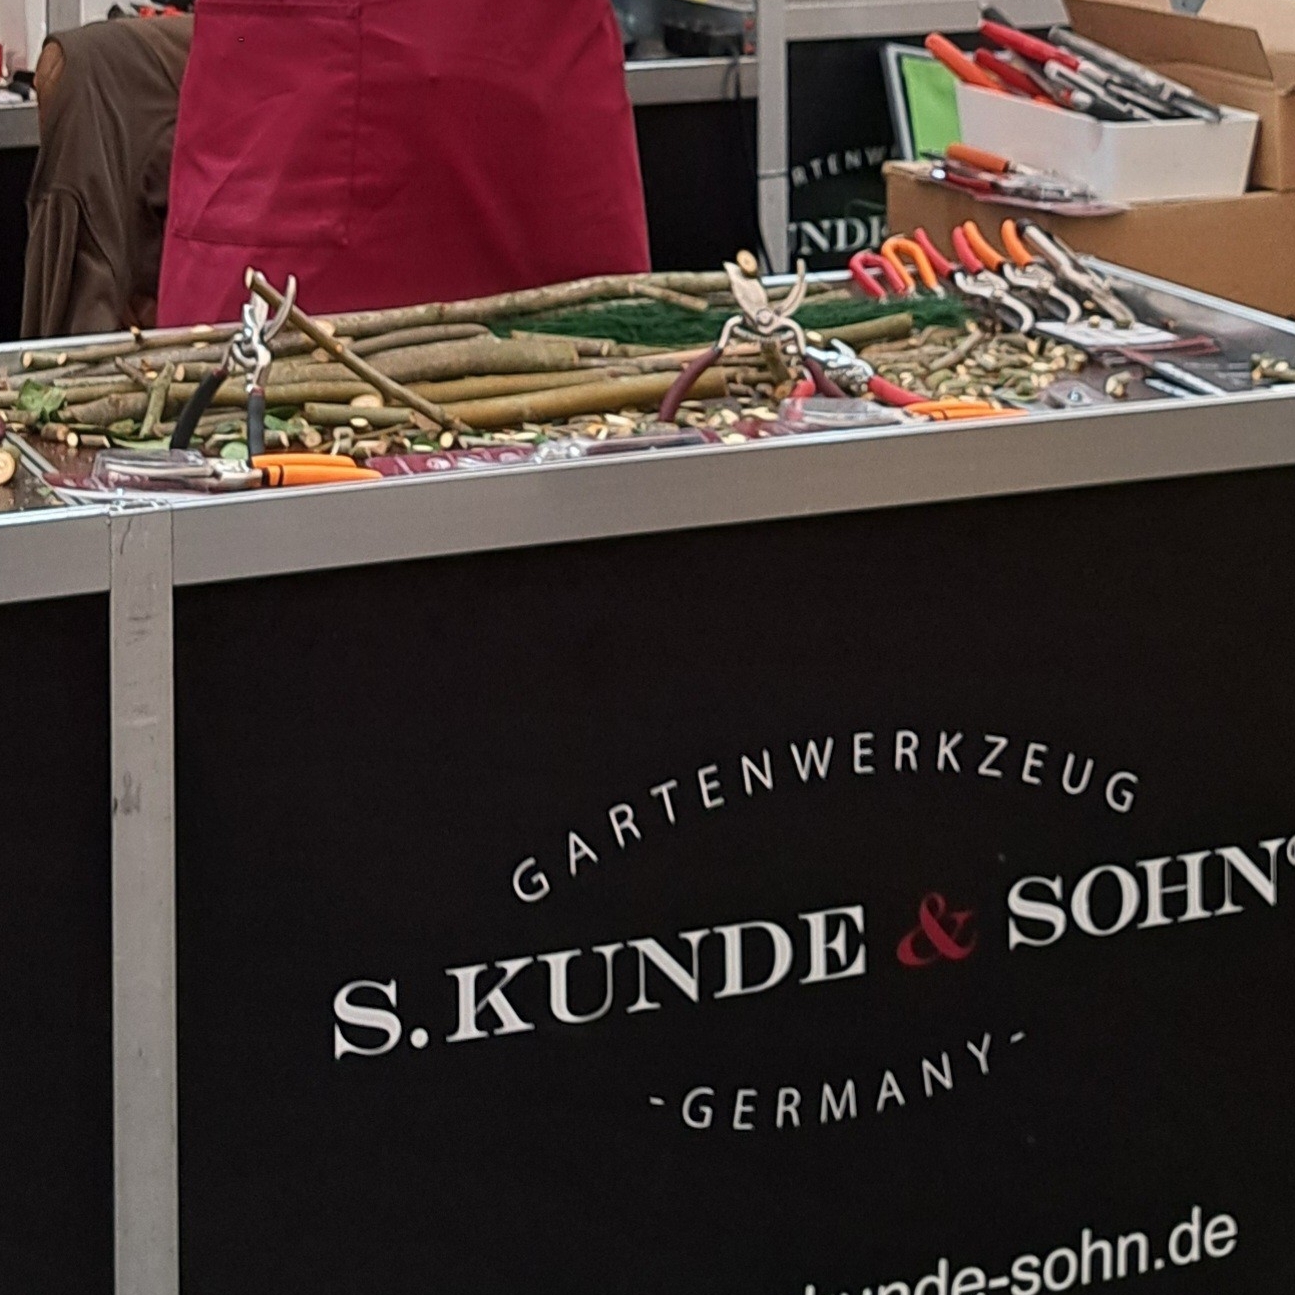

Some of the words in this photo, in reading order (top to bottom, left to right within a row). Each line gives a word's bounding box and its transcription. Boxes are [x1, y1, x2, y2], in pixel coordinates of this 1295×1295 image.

[513, 730, 1138, 901] GARTENWERKZEUG
[896, 891, 977, 966] &
[1006, 834, 1295, 951] SOHN
